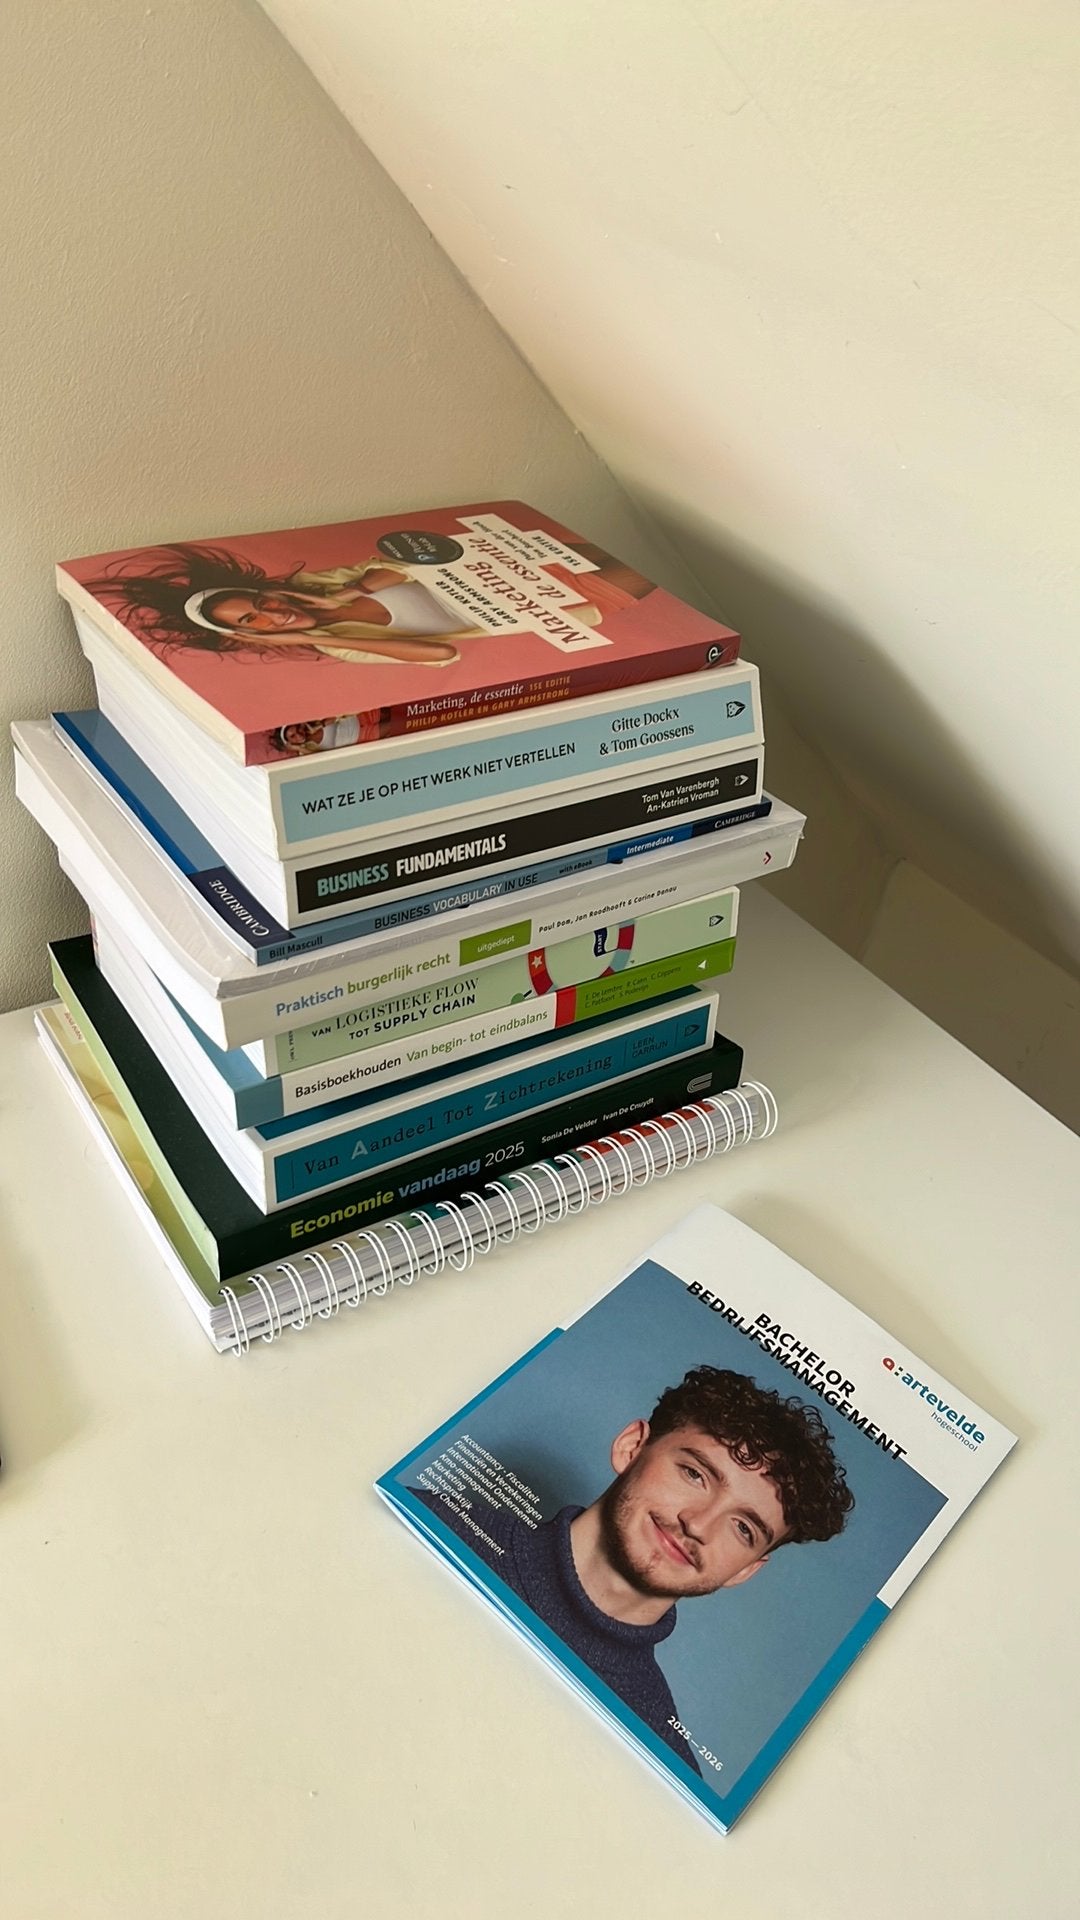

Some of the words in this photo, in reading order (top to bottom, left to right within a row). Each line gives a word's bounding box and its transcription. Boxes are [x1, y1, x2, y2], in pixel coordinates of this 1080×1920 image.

[468, 538, 542, 581] essentie
[532, 535, 564, 555] EDITIE
[435, 580, 471, 605] KOTLER
[437, 568, 493, 606] ARMSTRONG
[464, 561, 590, 644] Marketing
[536, 584, 567, 599] de
[469, 604, 503, 628] PHILIP
[490, 605, 519, 625] GARY
[406, 697, 467, 717] Marketing,
[470, 691, 482, 704] de
[484, 683, 524, 700] essentie
[529, 681, 542, 691] 15E
[545, 675, 571, 689] EDITIE
[406, 716, 437, 729] PHILIP
[440, 708, 474, 722] KOTLER
[477, 704, 489, 714] EN
[492, 699, 515, 712] GARY
[518, 688, 570, 705] ARMSTRONG
[611, 717, 642, 733] Gitte
[643, 707, 680, 725] Dockx
[599, 742, 609, 755] &
[611, 736, 638, 753] Tom
[640, 724, 695, 746] Goossens
[301, 796, 334, 815] WAT
[337, 792, 355, 807] ZE
[358, 788, 375, 802] JE
[378, 782, 399, 798] OP
[402, 775, 428, 793] HET
[430, 765, 472, 786] WERK
[473, 758, 503, 776] NIET
[504, 742, 576, 768] VERTELLEN
[642, 794, 659, 804] Tom
[659, 789, 675, 799] Van
[675, 777, 720, 794] Varenbergh
[646, 796, 689, 814] An-Katrien
[690, 788, 719, 801] Vroman
[317, 863, 389, 897] BUSINESS
[396, 834, 507, 877] FUNDAMENTALS
[209, 879, 270, 937] CAMBRIDGE
[269, 945, 286, 959] Bill
[287, 936, 323, 954] Mascull
[374, 904, 431, 929] BUSINESS
[432, 883, 503, 912] VOCABULARY
[504, 879, 516, 891] IN
[518, 872, 539, 888] USE
[559, 865, 573, 874] with
[626, 834, 674, 854] Intermediate
[276, 985, 344, 1017] Praktisch
[347, 966, 413, 994] burgerlijk
[416, 953, 451, 975] recht
[477, 934, 516, 953] uitgediept
[538, 922, 555, 933] Paul
[574, 912, 587, 923] Jan
[589, 900, 627, 918] Roodhooft
[633, 892, 656, 904] Carine
[656, 885, 678, 896] Danau
[311, 1026, 332, 1038] VAN
[335, 991, 432, 1030] LOGISTIEKE
[436, 977, 480, 1001] FLOW
[349, 1027, 370, 1040] TOT
[374, 1008, 428, 1034] SUPPLY
[432, 994, 477, 1016] CHAIN
[295, 1057, 401, 1098] Basisboekhouden
[406, 1048, 428, 1063] Van
[430, 1037, 467, 1055] begin-
[469, 1029, 486, 1042] tot
[489, 1011, 548, 1036] eindbalans
[632, 1036, 655, 1050] LEEN
[304, 1154, 340, 1175] Van
[351, 1117, 435, 1160] Aandeel
[443, 1104, 474, 1123] Tot
[484, 1055, 613, 1111] Zichtrekening
[290, 1190, 394, 1239] Economie
[398, 1157, 481, 1198] vandaag
[484, 1140, 526, 1167] 2025
[541, 1131, 562, 1144] Sonia
[563, 1126, 574, 1136] De
[574, 1118, 598, 1131] Velder
[602, 1110, 618, 1121] Ivan
[620, 1106, 629, 1115] De
[686, 1280, 908, 1461] BEDRIJFSMANAGEMENT
[754, 1312, 856, 1399] BACHELOR
[930, 1411, 978, 1452] hogeschool
[424, 1466, 473, 1511] Rechtspraktijk
[432, 1460, 467, 1492] Marketing
[439, 1453, 502, 1510] Kmo-management
[446, 1446, 497, 1490] Internationaal
[493, 1487, 538, 1531] Ondernemen
[454, 1440, 488, 1471] Financiën
[485, 1467, 497, 1479] en
[496, 1474, 543, 1521] Verzekeringen
[461, 1434, 504, 1470] Accountancy
[505, 1471, 540, 1504] Fiscaliteit
[416, 1473, 441, 1496] Supply
[439, 1492, 461, 1514] Chain
[458, 1510, 505, 1556] Management
[667, 1715, 692, 1741] 2025
[698, 1745, 724, 1772] 2026
